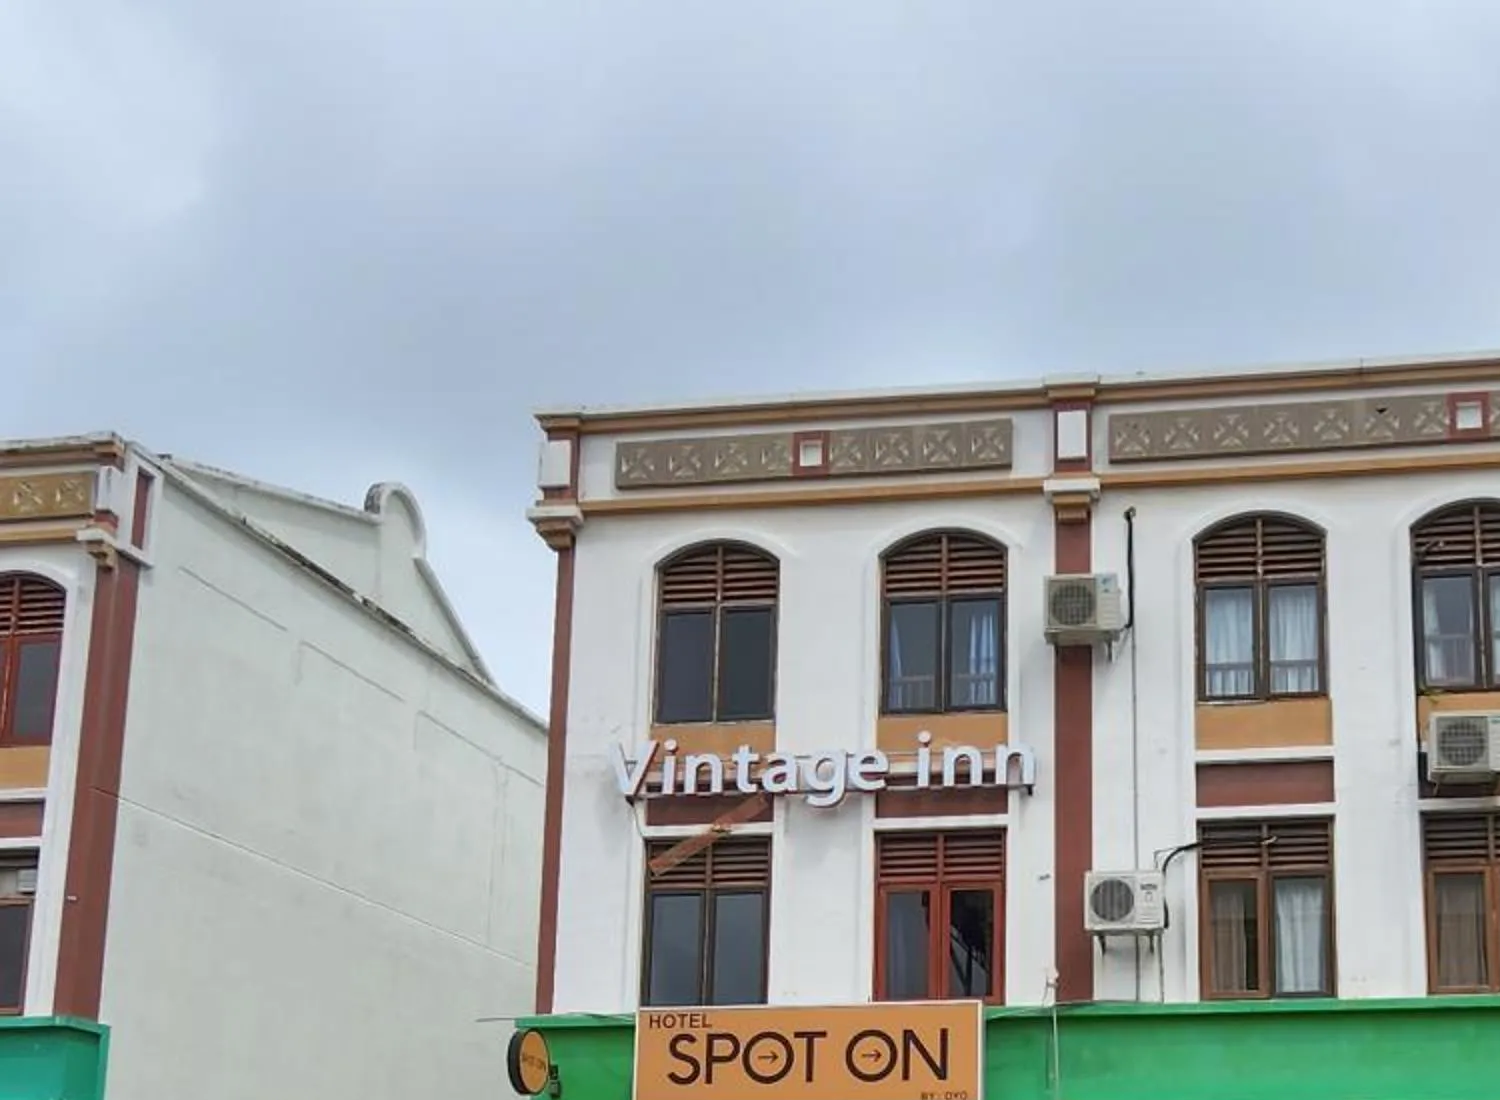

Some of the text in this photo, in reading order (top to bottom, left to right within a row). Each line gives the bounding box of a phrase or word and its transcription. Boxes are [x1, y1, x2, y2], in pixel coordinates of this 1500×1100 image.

[610, 730, 1038, 807] Vintage inn
[649, 1012, 713, 1030] HOTEL
[667, 1028, 949, 1086] SPOT ON
